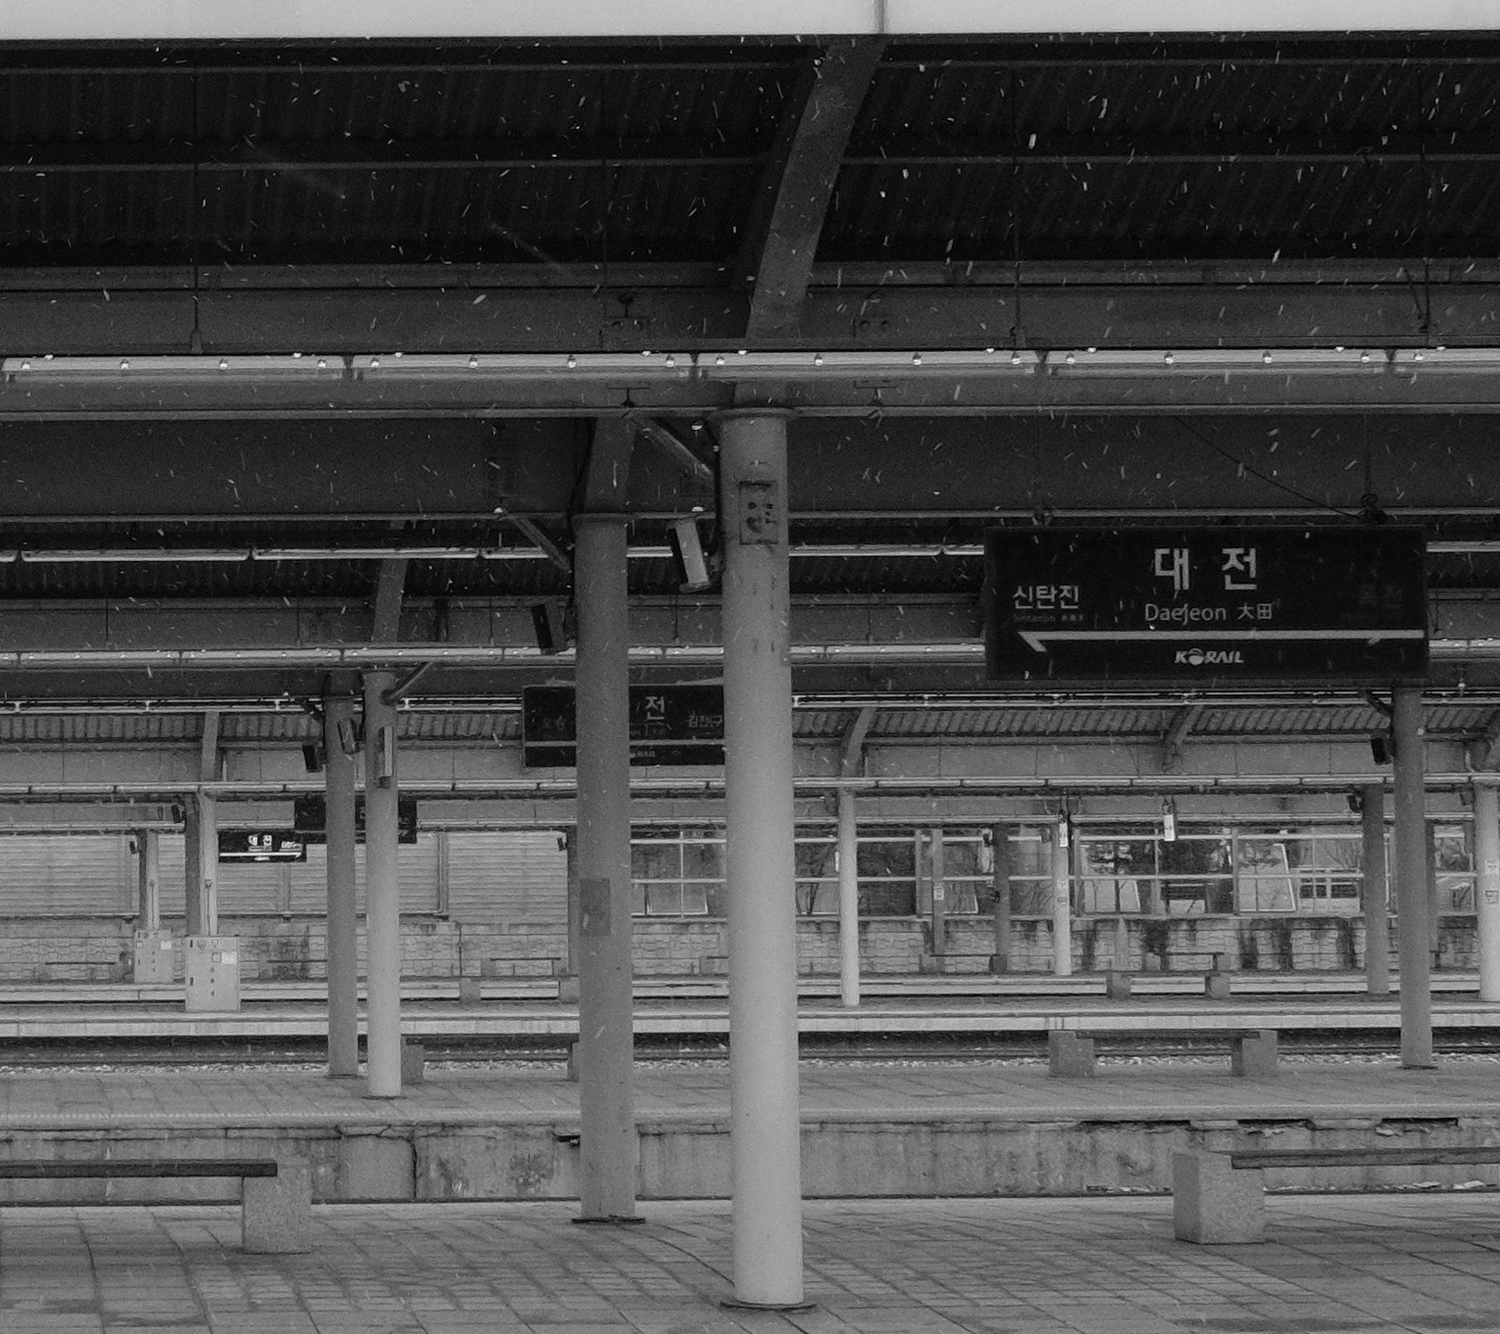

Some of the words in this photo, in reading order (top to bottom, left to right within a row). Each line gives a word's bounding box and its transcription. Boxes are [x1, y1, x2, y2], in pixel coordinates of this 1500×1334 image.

[1153, 546, 1259, 591] 대전
[1011, 583, 1081, 610] 신탄진
[1144, 602, 1226, 626] Daejeon
[1236, 601, 1273, 620] 大田
[1173, 647, 1245, 666] KORAIL
